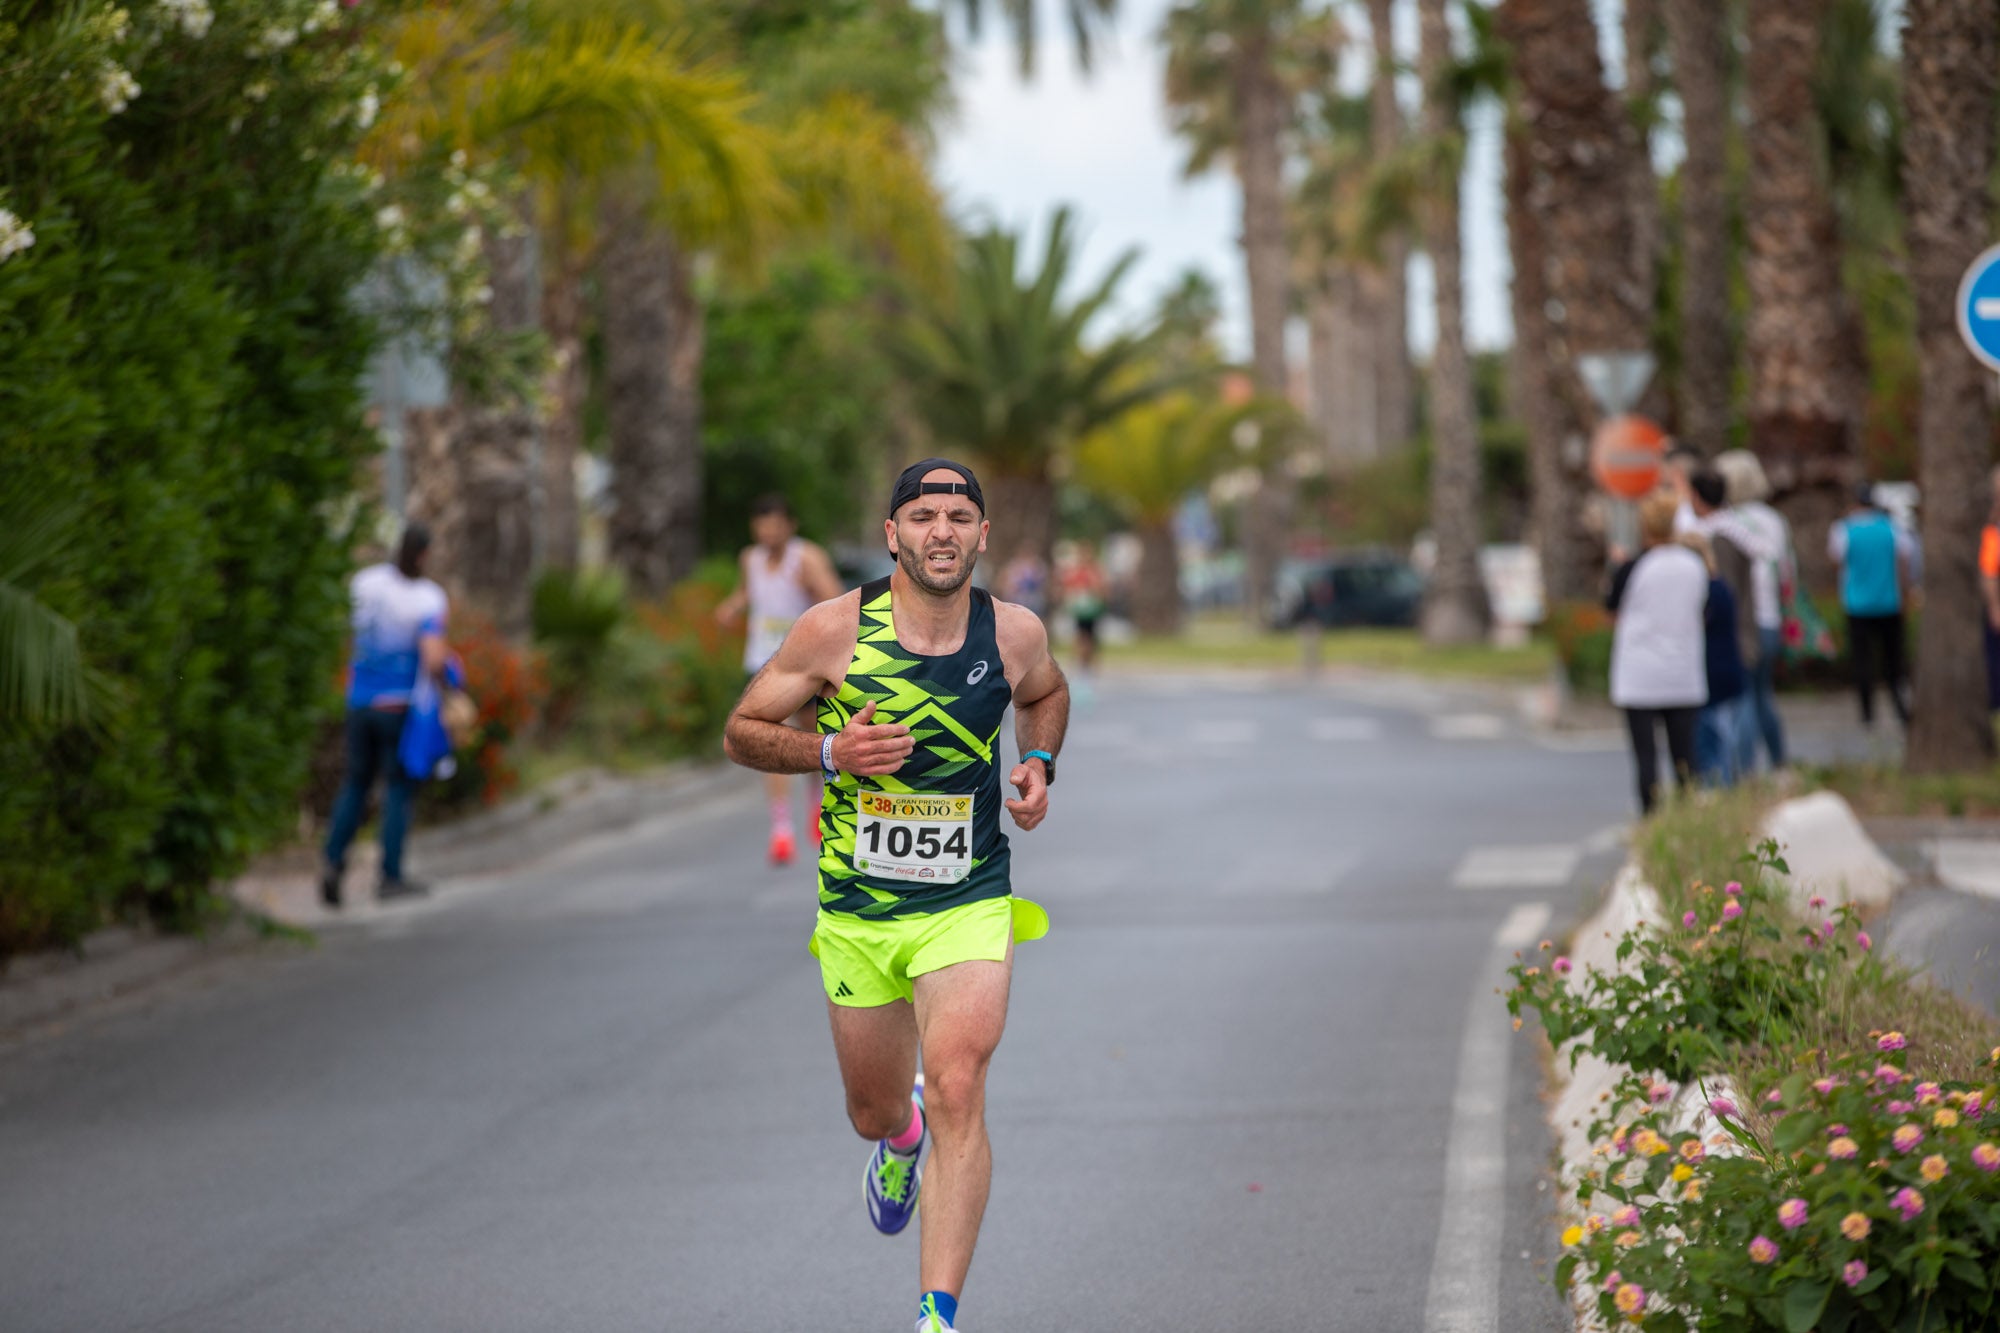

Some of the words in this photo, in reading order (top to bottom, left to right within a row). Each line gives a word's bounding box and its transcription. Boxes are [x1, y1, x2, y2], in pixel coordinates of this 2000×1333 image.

[874, 797, 892, 813] 38
[892, 805, 950, 816] FONDO
[863, 821, 968, 859] 1054
